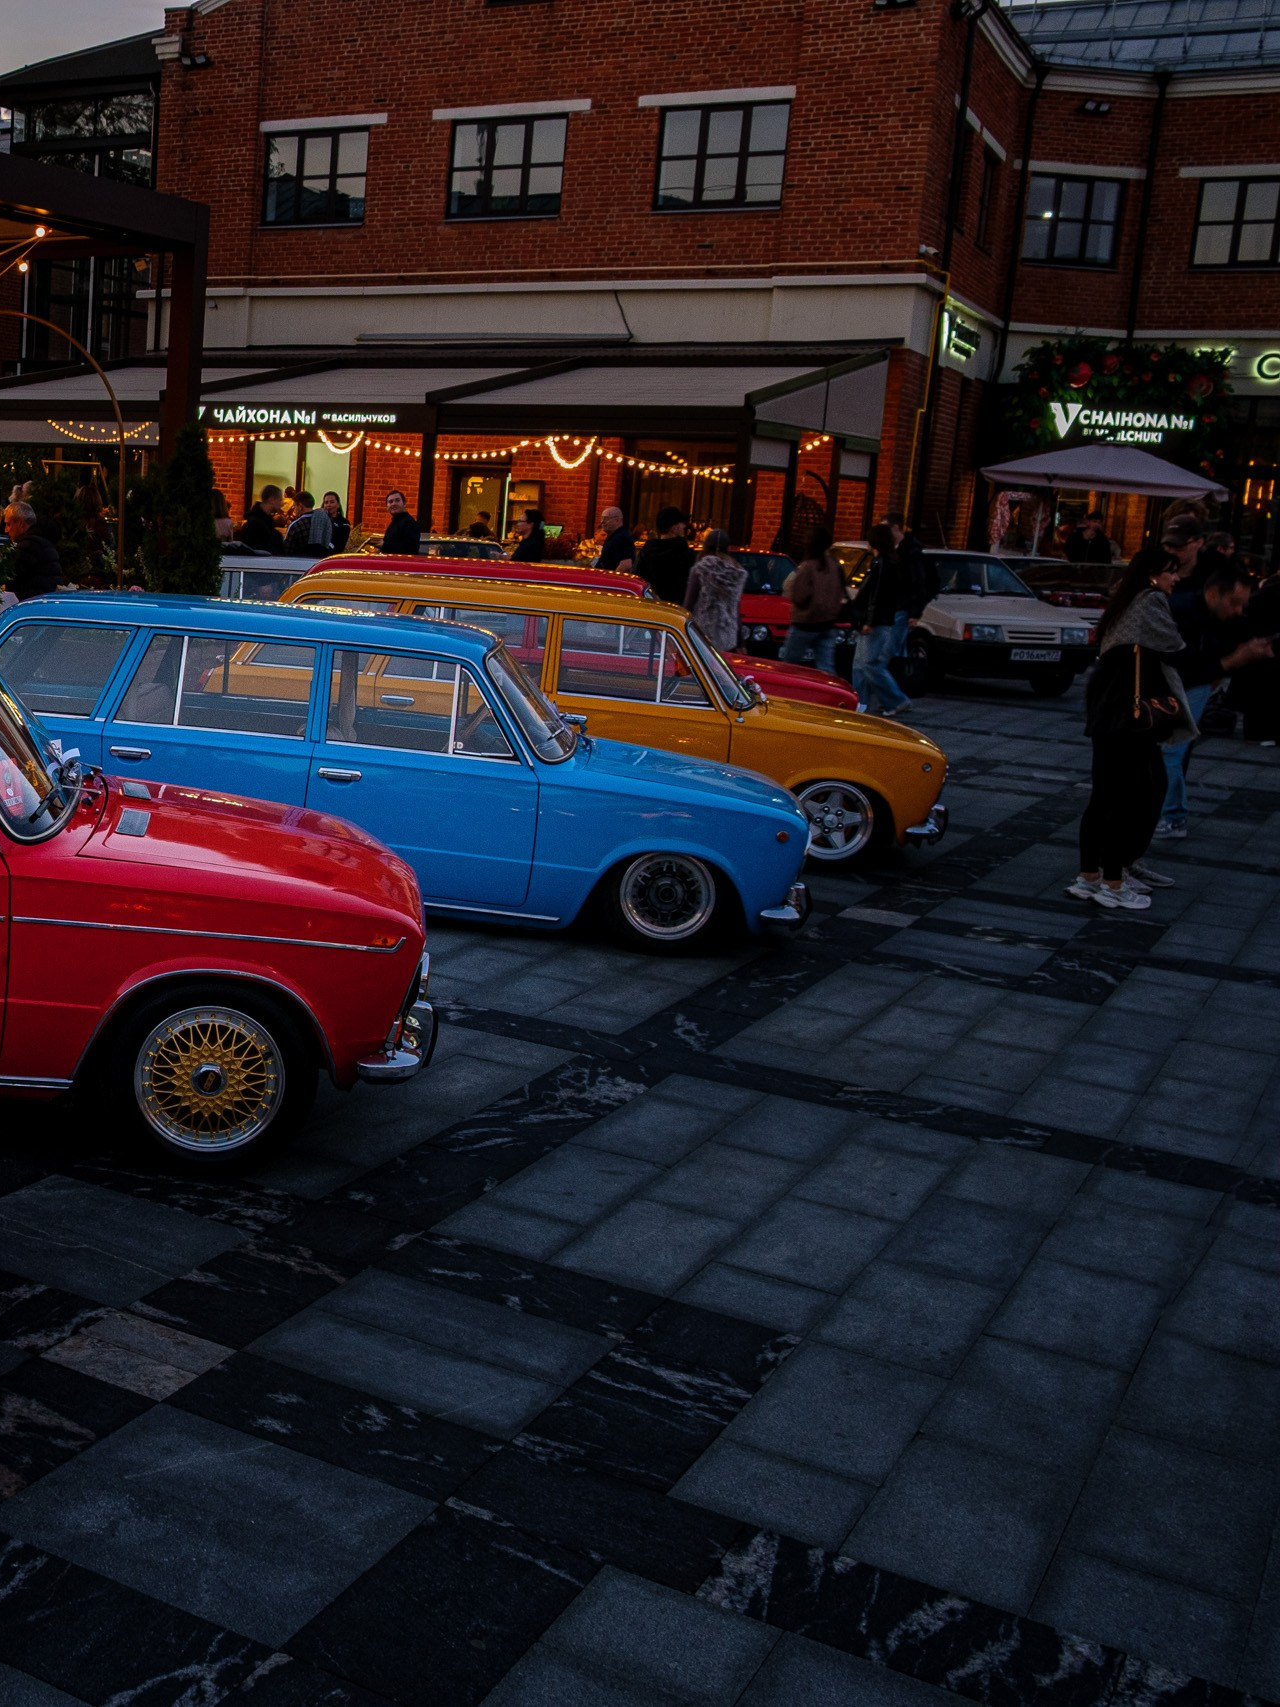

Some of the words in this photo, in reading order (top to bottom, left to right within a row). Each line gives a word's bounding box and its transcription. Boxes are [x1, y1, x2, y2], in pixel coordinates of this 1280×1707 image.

[213, 406, 291, 424] ЧАЙХОНА
[294, 410, 316, 425] №1
[331, 413, 397, 423] ВАСИЛЬЧУКОВ
[1079, 410, 1168, 429] CHAIHONA
[1082, 428, 1093, 436] BY
